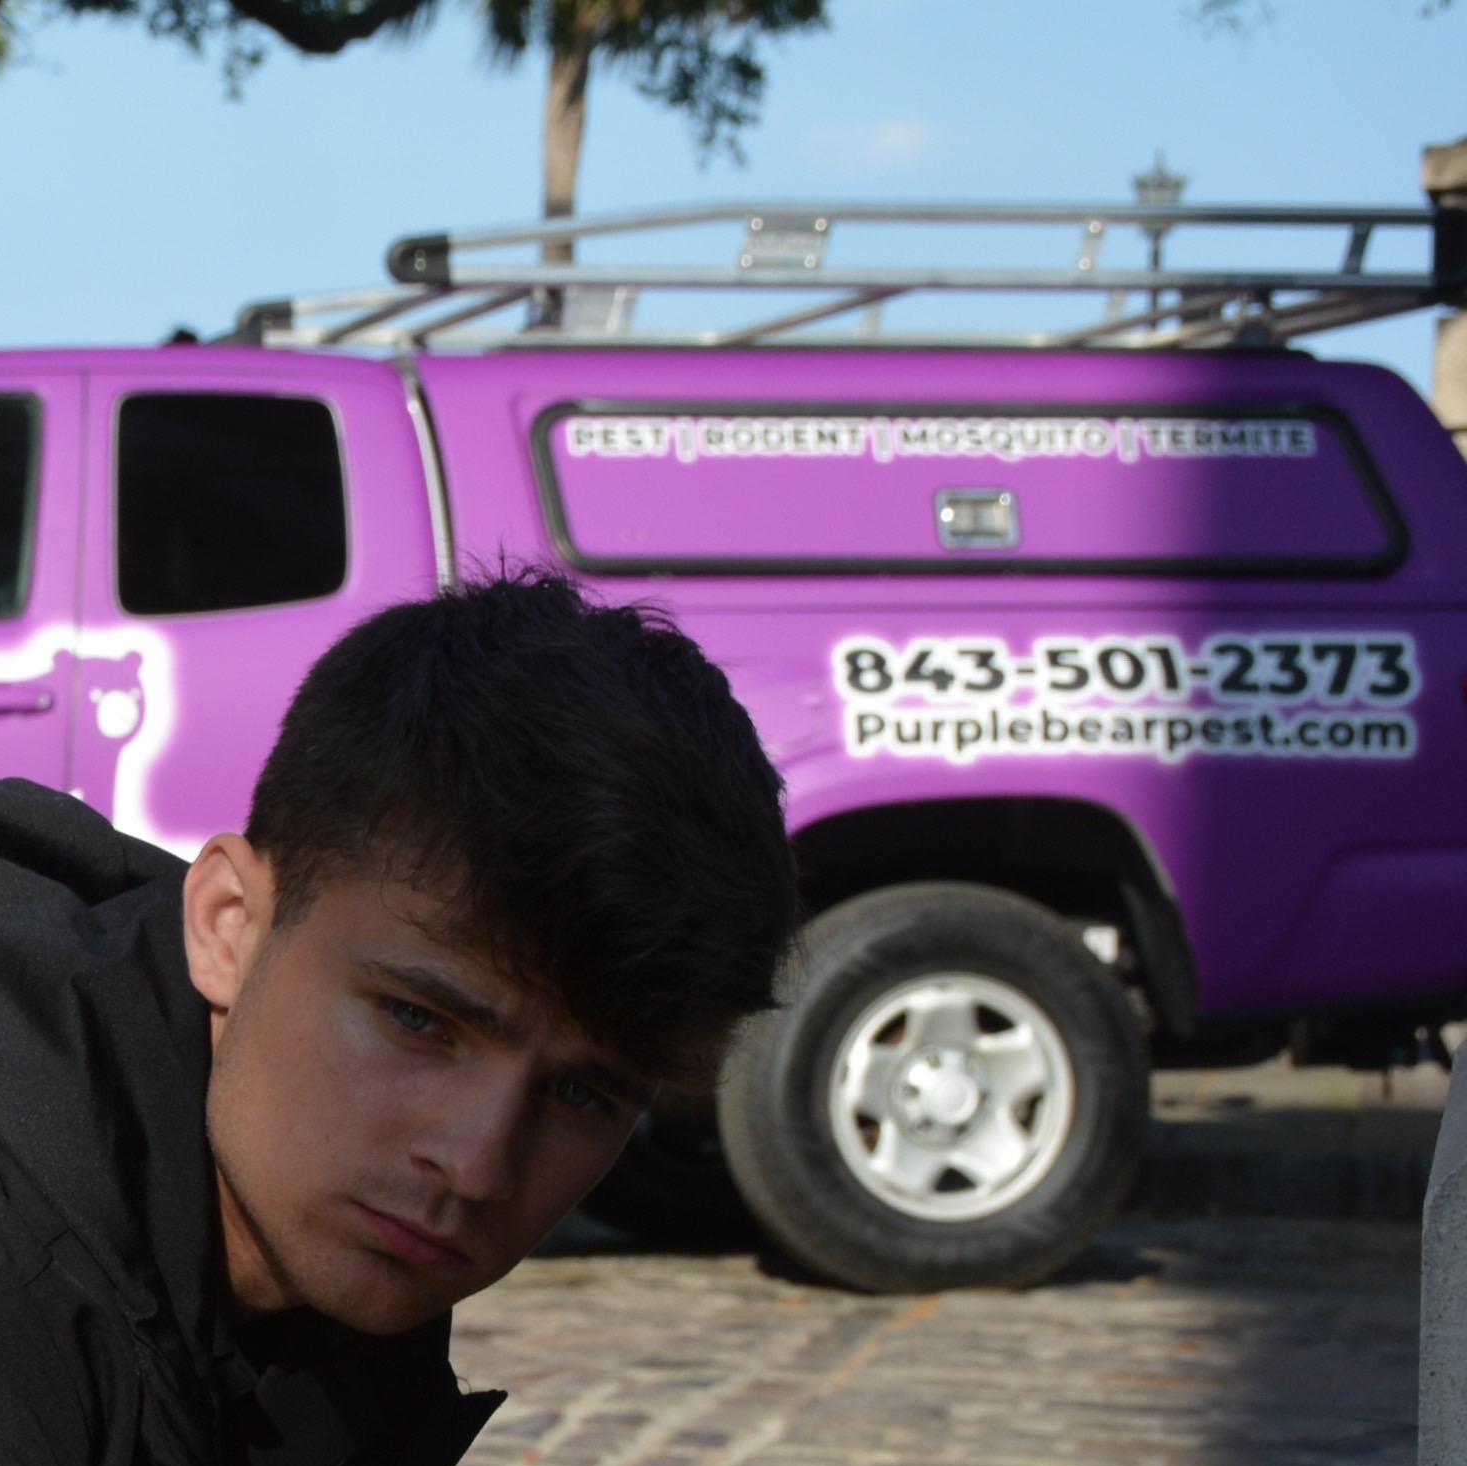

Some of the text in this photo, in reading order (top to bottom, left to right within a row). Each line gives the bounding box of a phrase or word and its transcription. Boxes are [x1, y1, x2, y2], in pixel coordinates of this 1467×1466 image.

[574, 427, 1312, 452] PEST RODENT MOSQUITO TERMITE
[845, 643, 1411, 695] 843-501-2373
[857, 709, 1407, 751] Purplebearpest.com
